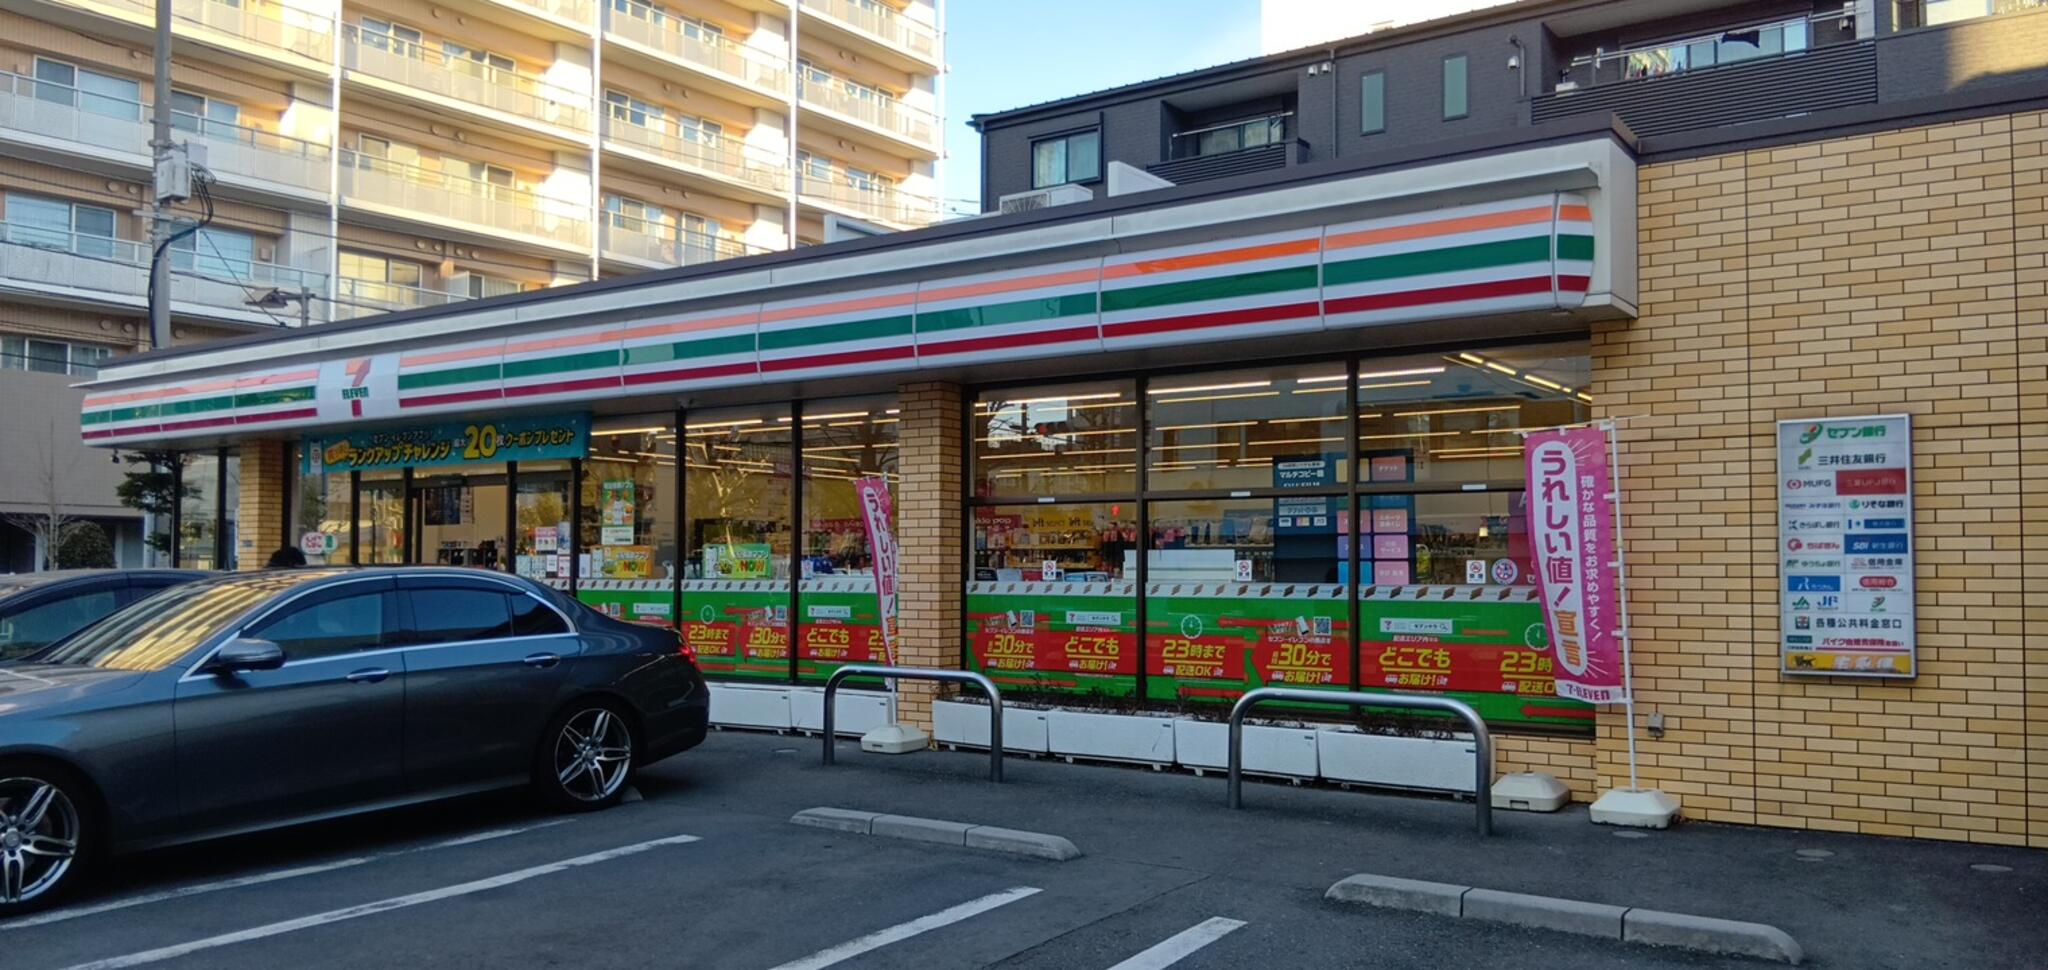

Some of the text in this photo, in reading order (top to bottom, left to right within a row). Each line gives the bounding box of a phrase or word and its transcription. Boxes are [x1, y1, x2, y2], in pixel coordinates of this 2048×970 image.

[1827, 425, 1886, 439] セブン銀行
[348, 441, 450, 466] ランクアップチャレンジ
[1818, 453, 1886, 466] 三井住友銀行
[1804, 479, 1831, 488] MUFG
[1861, 500, 1904, 508] りそな銀行
[1816, 618, 1902, 629] 各種公共料金窓口
[807, 628, 849, 644] どこでも
[1065, 636, 1120, 655] どこでも
[1162, 640, 1226, 659] 23時まで
[1379, 646, 1451, 669] どこでも
[997, 659, 1026, 670] お届け!
[1079, 659, 1108, 670] お届け!
[1175, 665, 1212, 677] 配送OK
[1284, 671, 1321, 684] お届け!
[1398, 674, 1436, 689] お届け!
